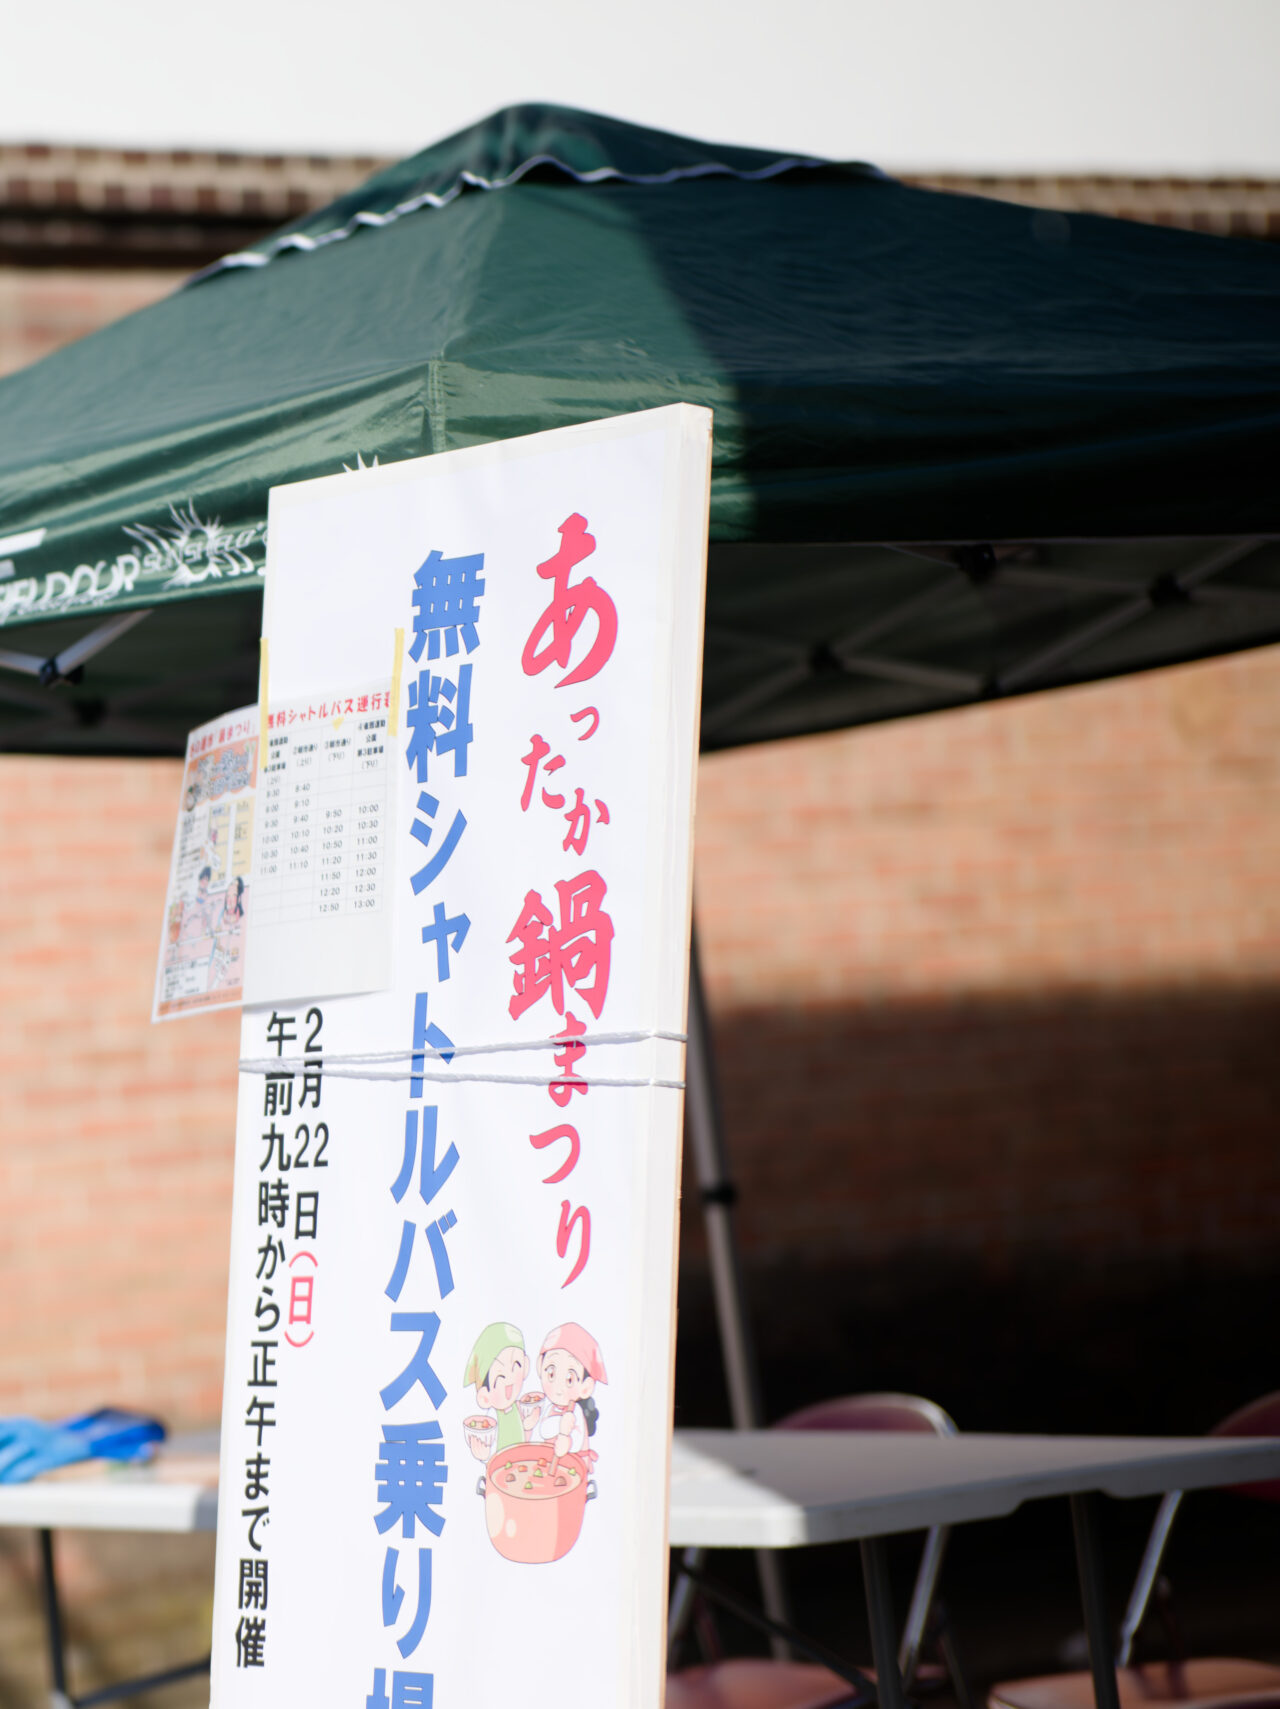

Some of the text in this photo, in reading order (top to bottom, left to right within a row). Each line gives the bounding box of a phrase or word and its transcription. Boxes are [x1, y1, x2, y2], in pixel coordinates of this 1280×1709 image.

[358, 804, 379, 814] 10:00
[323, 824, 344, 835] 10:20
[358, 820, 378, 830] 10:30
[322, 840, 343, 850] 10:50
[357, 835, 378, 845] 11:00
[322, 856, 342, 865] 11:20
[356, 851, 377, 861] 11:30
[321, 867, 377, 881] 11:50 12:00
[320, 883, 376, 897] 12:20 12:30
[319, 898, 375, 912] 12:50 13:00
[506, 512, 618, 1289] あったか鍋まつり
[234, 1010, 298, 1670] 午前九時から正午まで開催
